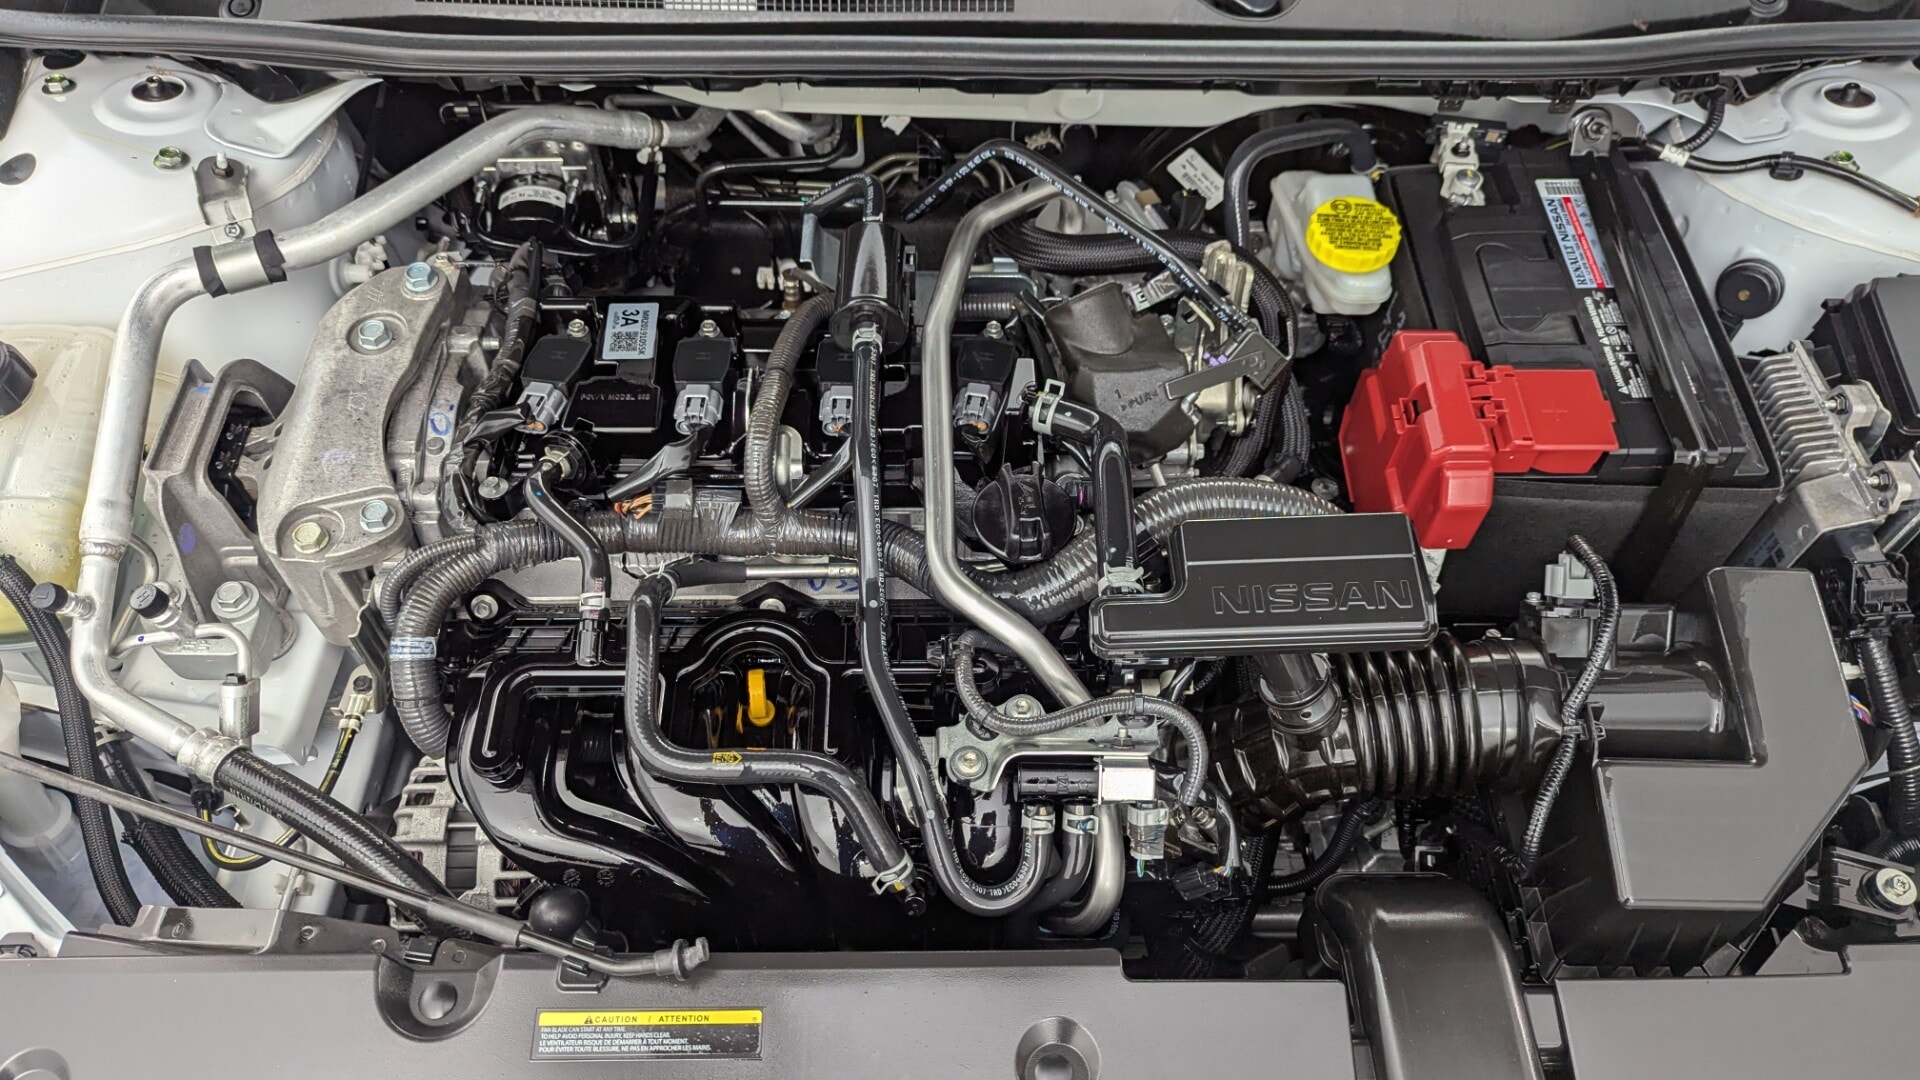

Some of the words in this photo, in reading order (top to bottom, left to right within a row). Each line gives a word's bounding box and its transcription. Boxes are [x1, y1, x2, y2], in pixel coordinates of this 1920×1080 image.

[1545, 199, 1571, 242] NISSAN
[1564, 244, 1588, 286] RENAULT
[620, 309, 640, 327] 3A
[1212, 580, 1414, 615] NISSAN
[658, 1015, 710, 1023] ATTENTION
